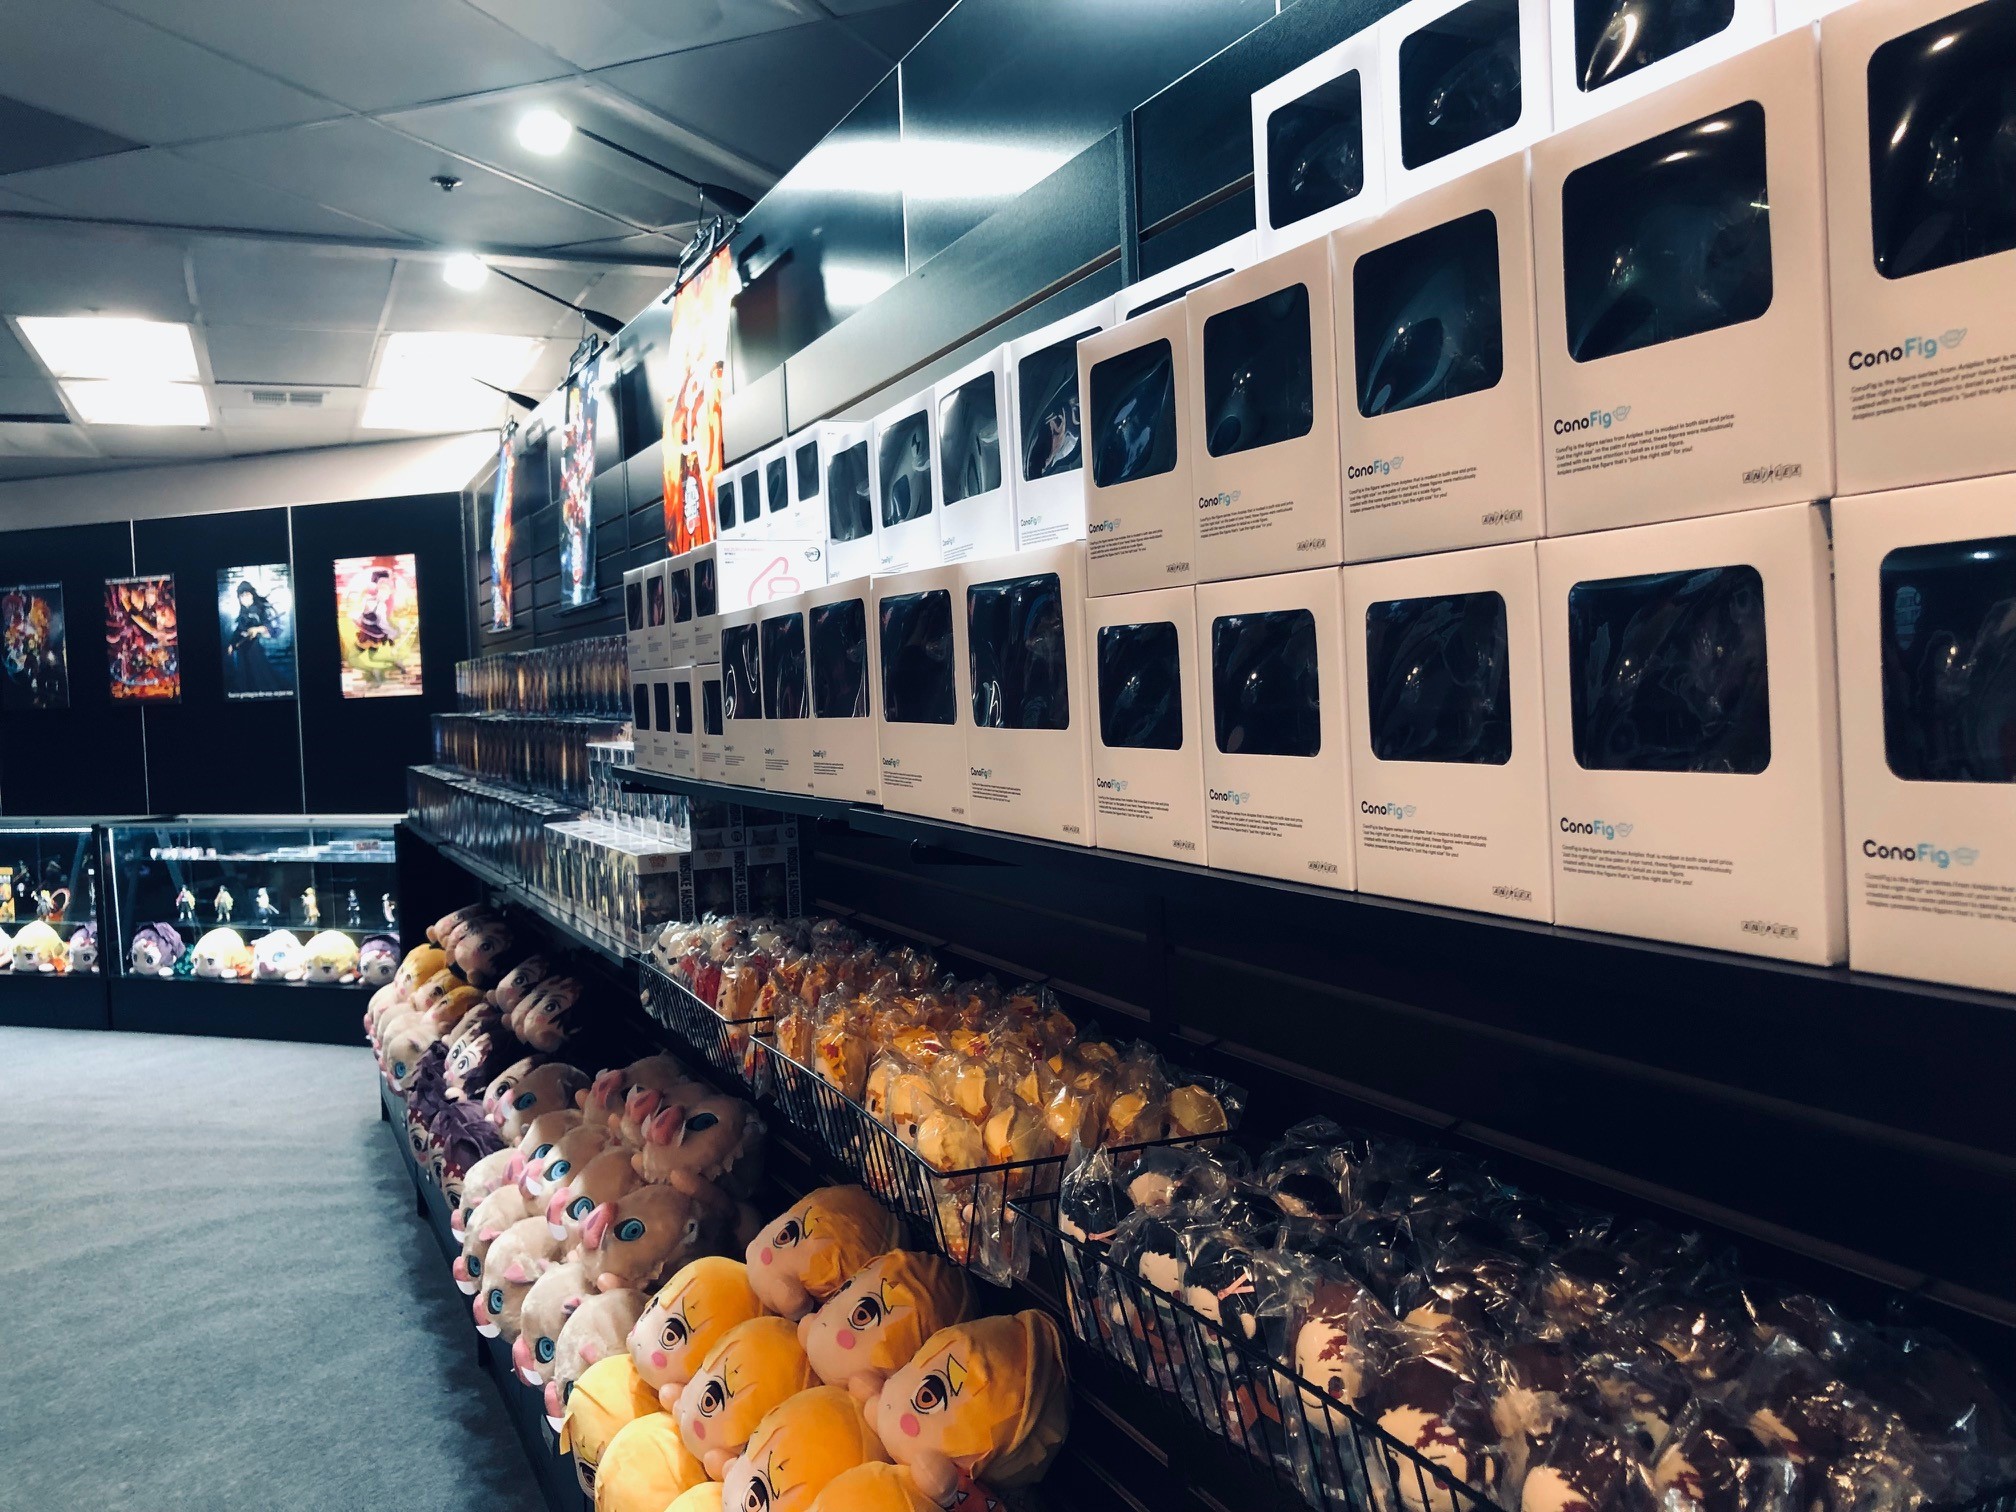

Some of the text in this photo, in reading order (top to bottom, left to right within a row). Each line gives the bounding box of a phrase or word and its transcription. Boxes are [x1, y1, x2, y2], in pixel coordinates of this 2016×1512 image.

[1848, 336, 1937, 370] ConoFig
[1553, 410, 1612, 435] ConoFig
[1347, 460, 1390, 479] ConoFig
[1742, 464, 1802, 484] ANIPLEX
[1198, 493, 1231, 509] ConoFig
[1088, 520, 1114, 533] ConoFig
[1096, 778, 1121, 792] ConoFig
[1209, 788, 1240, 805] ConoFig
[1360, 800, 1403, 820] ConoFig
[1560, 817, 1615, 840] ConoFig
[1863, 839, 1951, 869] ConoFig
[1492, 886, 1532, 902] ANIPLEX
[1741, 920, 1799, 940] ANIPLEX
